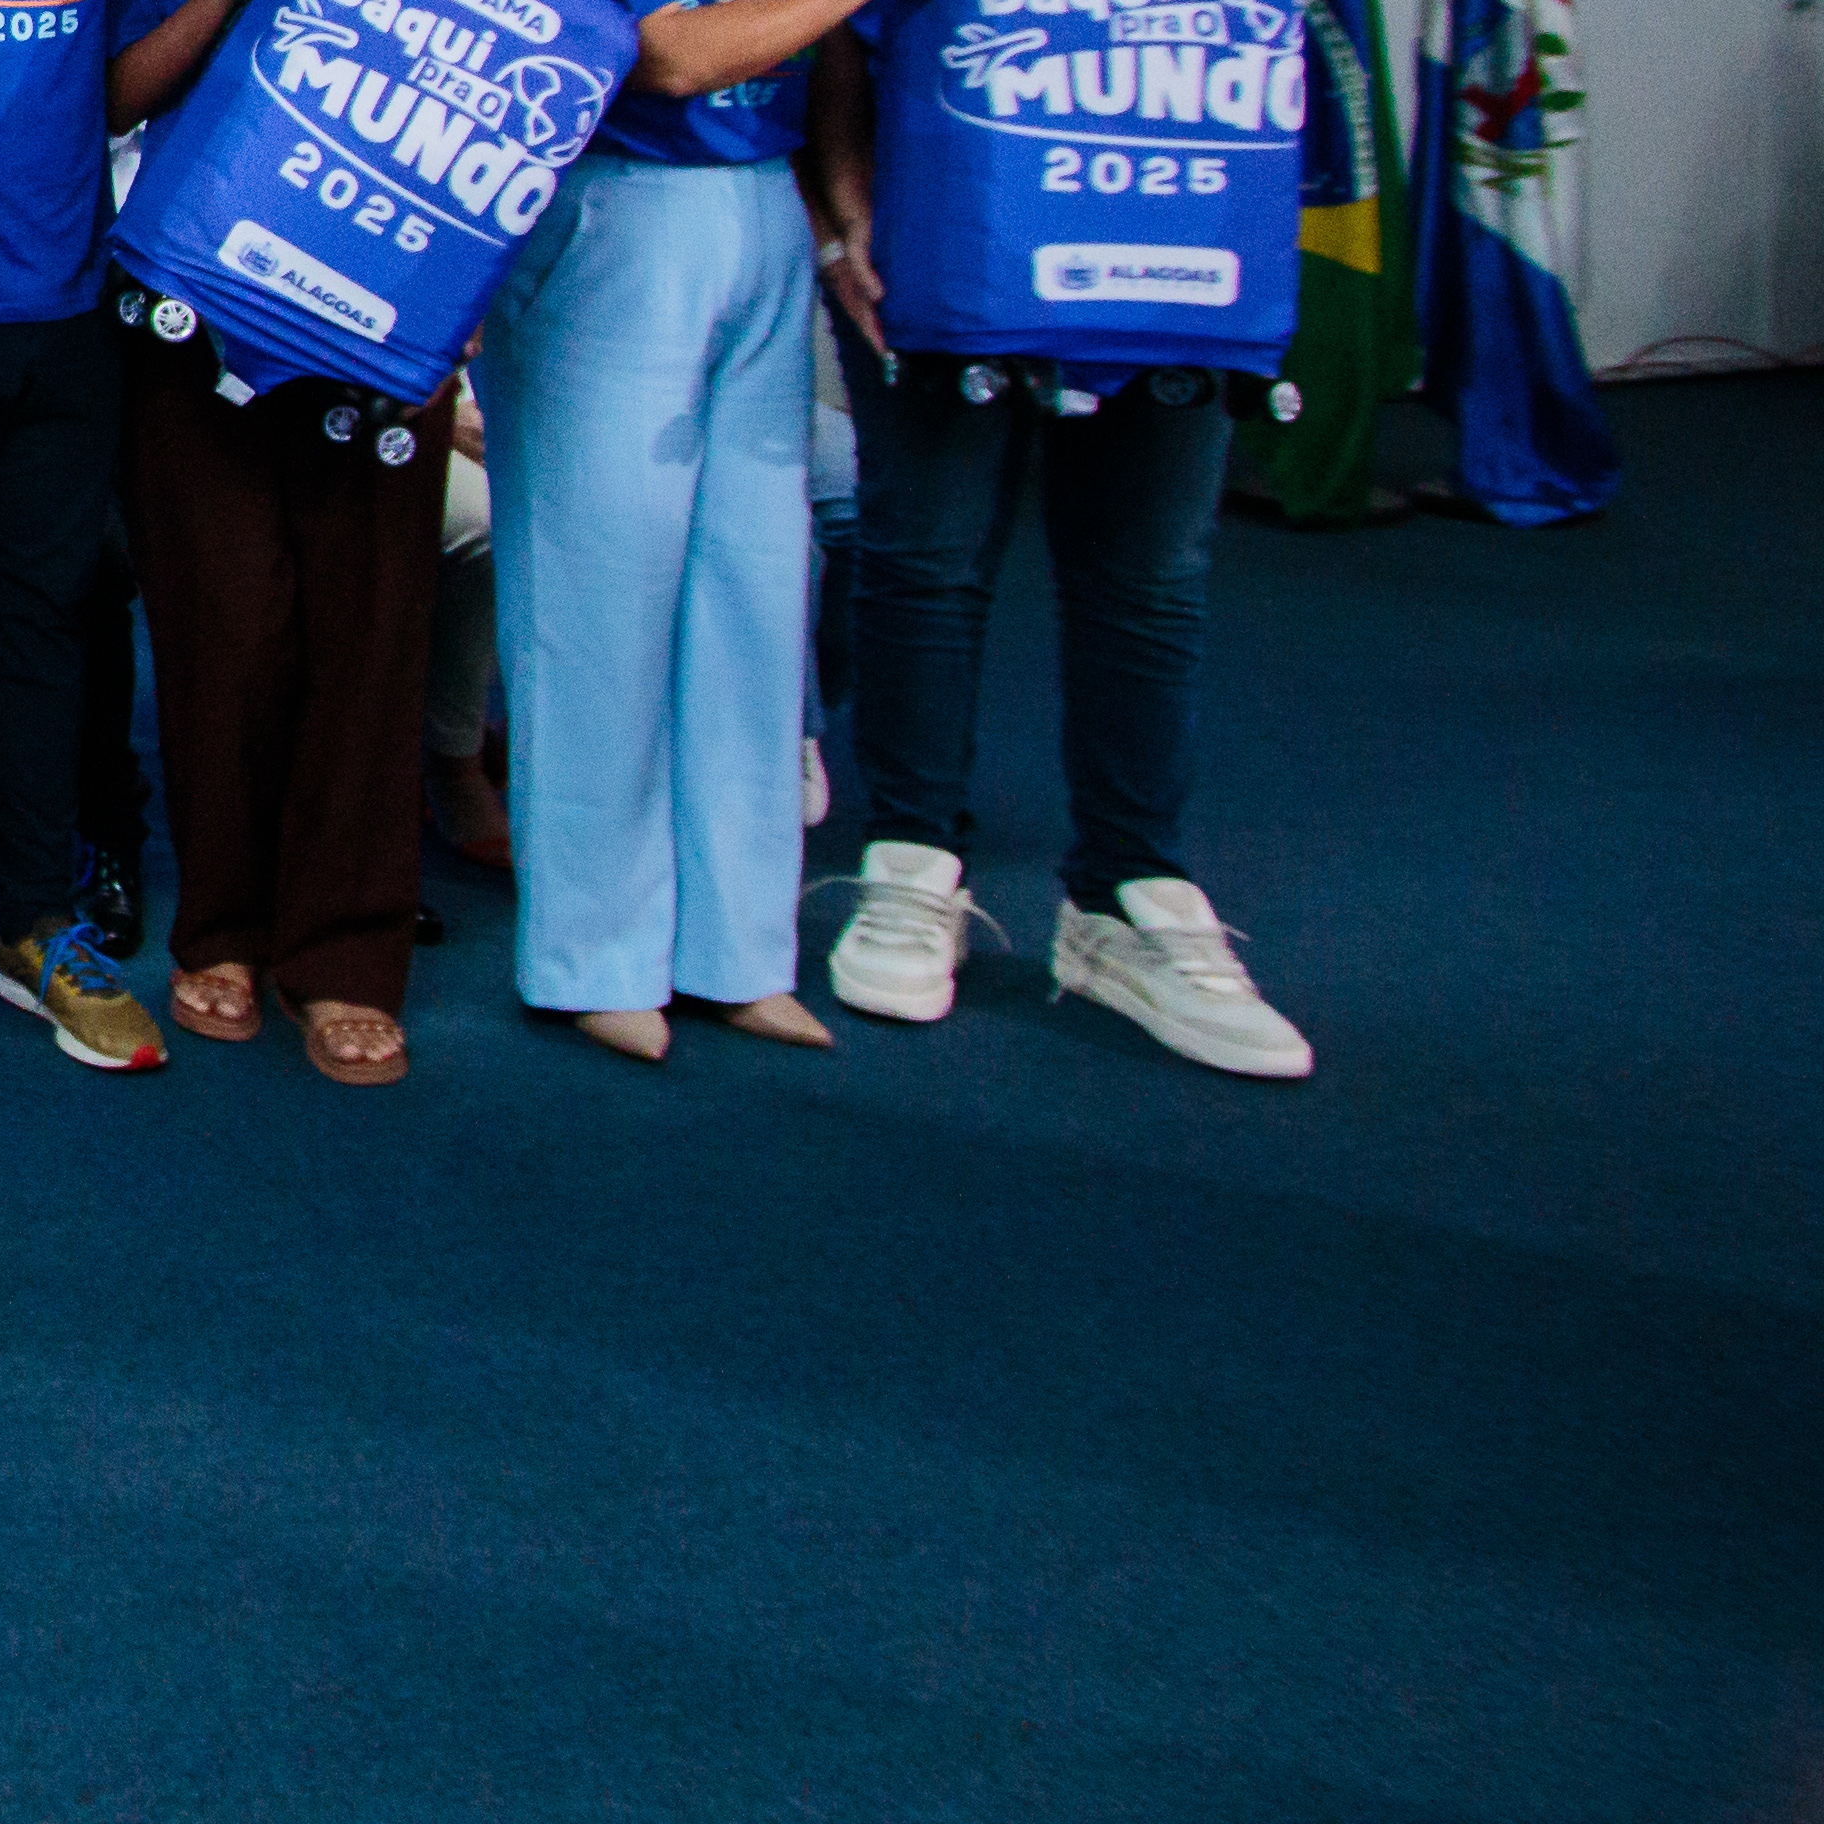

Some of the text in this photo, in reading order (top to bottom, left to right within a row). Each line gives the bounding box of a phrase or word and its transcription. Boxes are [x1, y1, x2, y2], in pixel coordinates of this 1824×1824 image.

[1116, 14, 1182, 39] pra
[416, 60, 473, 103] pra
[1040, 146, 1228, 195] 2025
[280, 142, 436, 253] 2025
[281, 269, 377, 329] ALAGOAS
